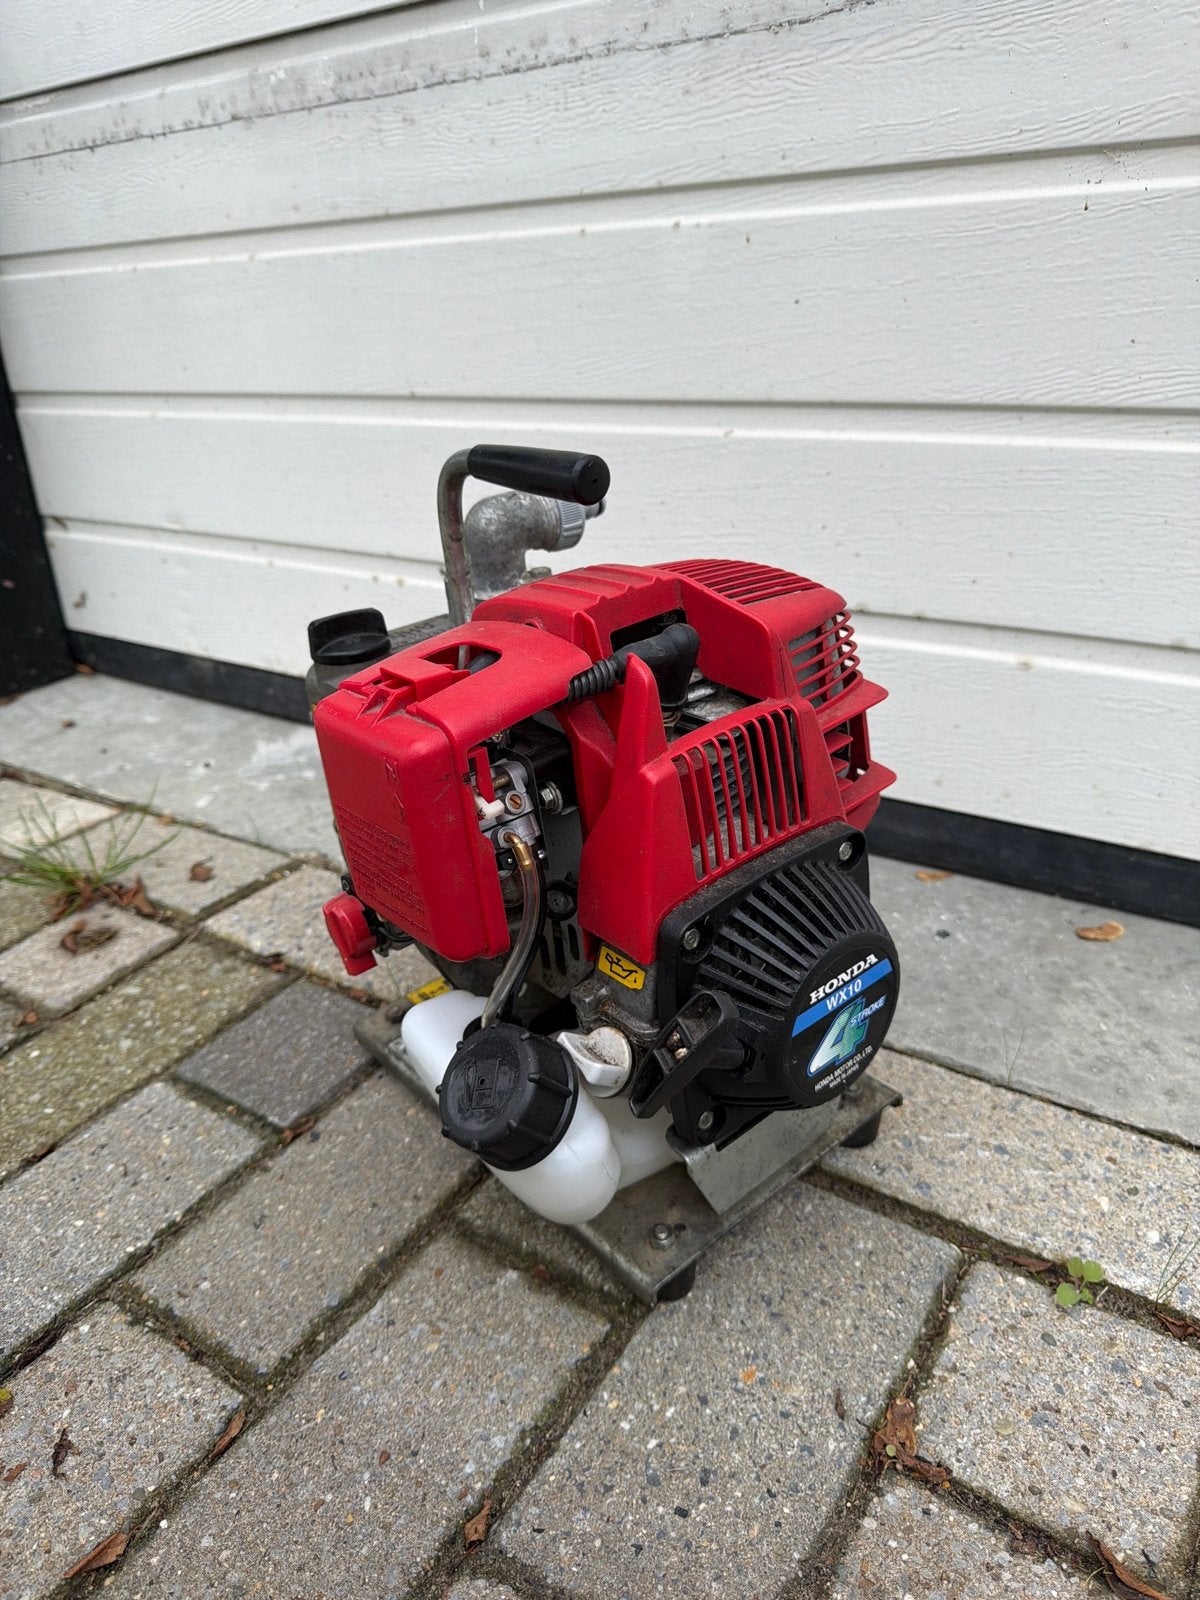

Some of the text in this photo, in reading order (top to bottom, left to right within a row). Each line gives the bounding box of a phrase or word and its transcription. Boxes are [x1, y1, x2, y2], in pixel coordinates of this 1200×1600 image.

[810, 953, 878, 1004] HONDA
[826, 979, 862, 1011] WX10
[850, 995, 888, 1027] STROKE
[807, 996, 869, 1077] 4
[814, 1073, 834, 1092] HONDA
[834, 1059, 853, 1077] MOTOR
[829, 1075, 841, 1088] MADE
[846, 1063, 859, 1076] JAPAN
